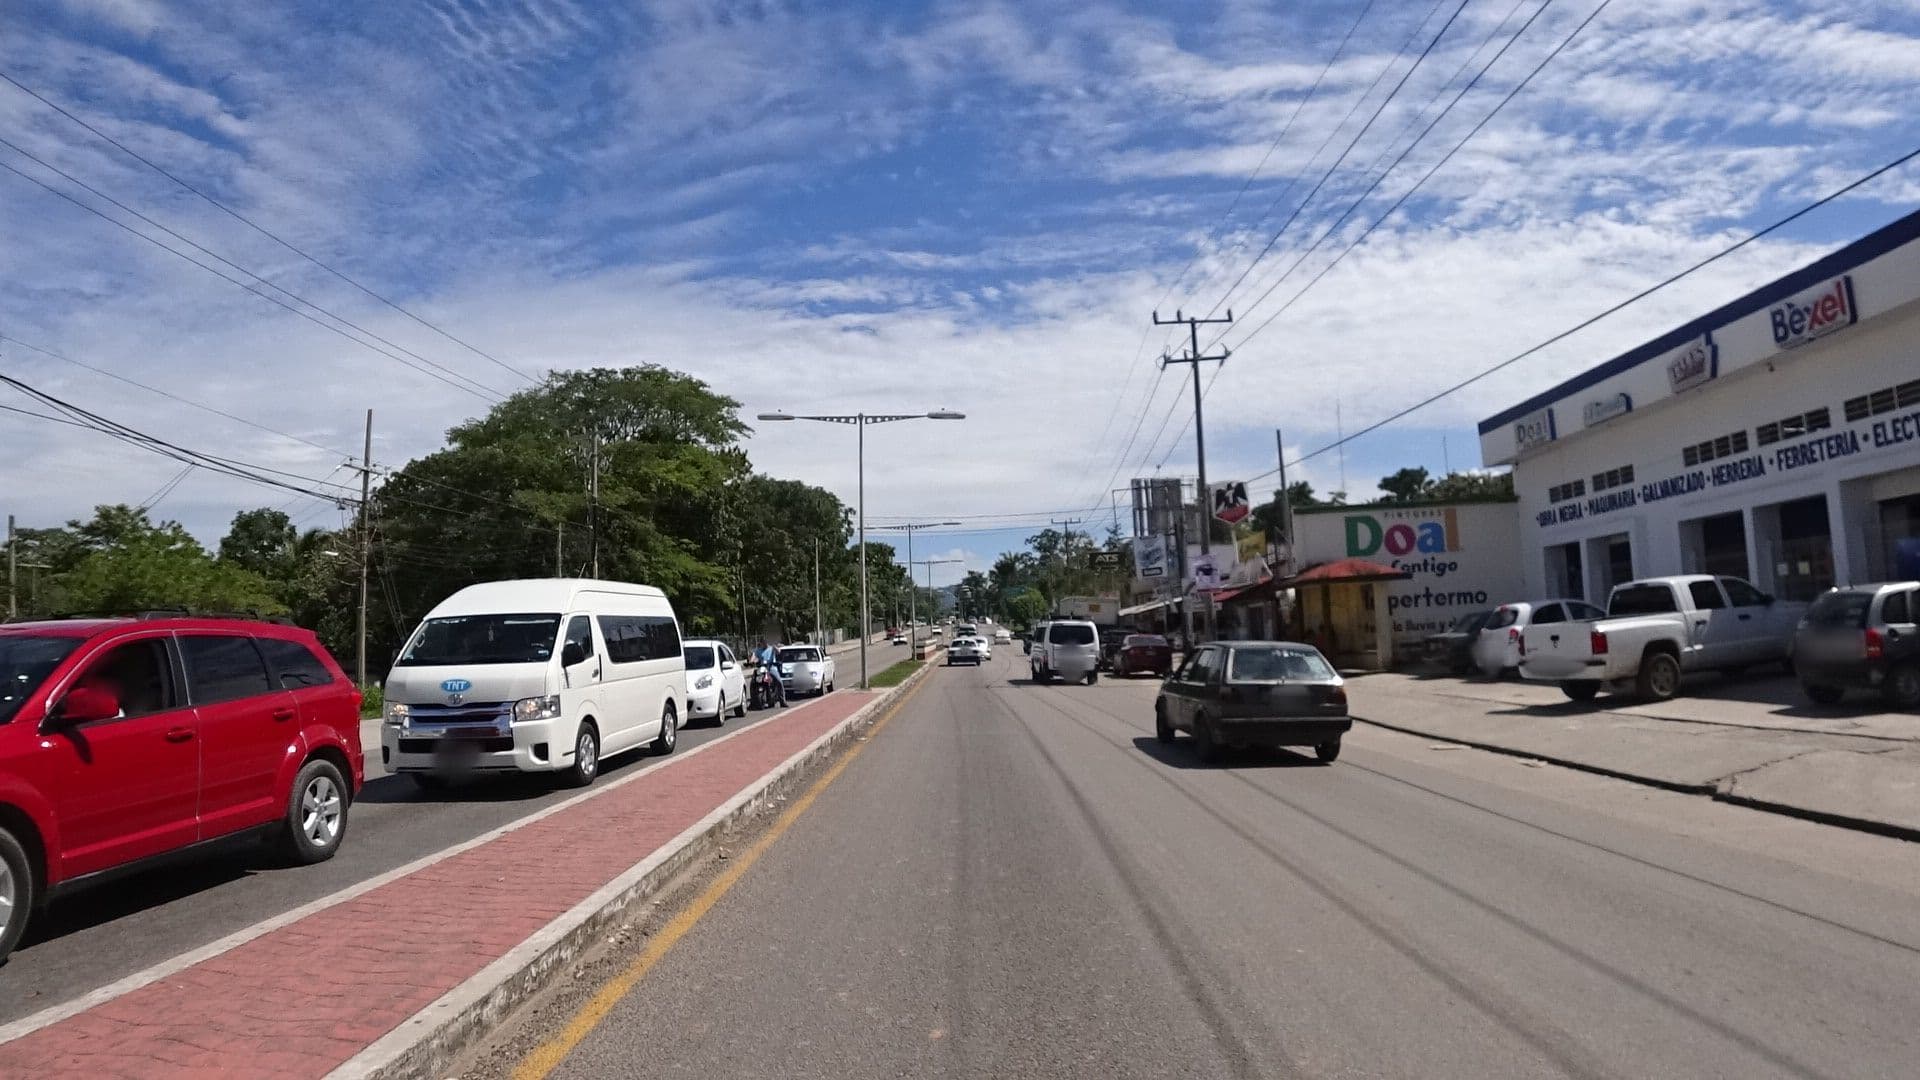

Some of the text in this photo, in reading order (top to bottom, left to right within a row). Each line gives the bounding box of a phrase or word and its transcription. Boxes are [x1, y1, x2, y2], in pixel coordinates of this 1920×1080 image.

[1538, 509, 1558, 527] OBRA
[1559, 502, 1583, 521] NEGRA
[1588, 488, 1637, 516] MAQUINARIA
[1642, 470, 1705, 503] GALVANIZADO
[1711, 454, 1766, 487] HERRERIA
[1776, 430, 1861, 471] FERRETERIA
[1344, 508, 1459, 557] Doal
[446, 681, 467, 690] TNT
